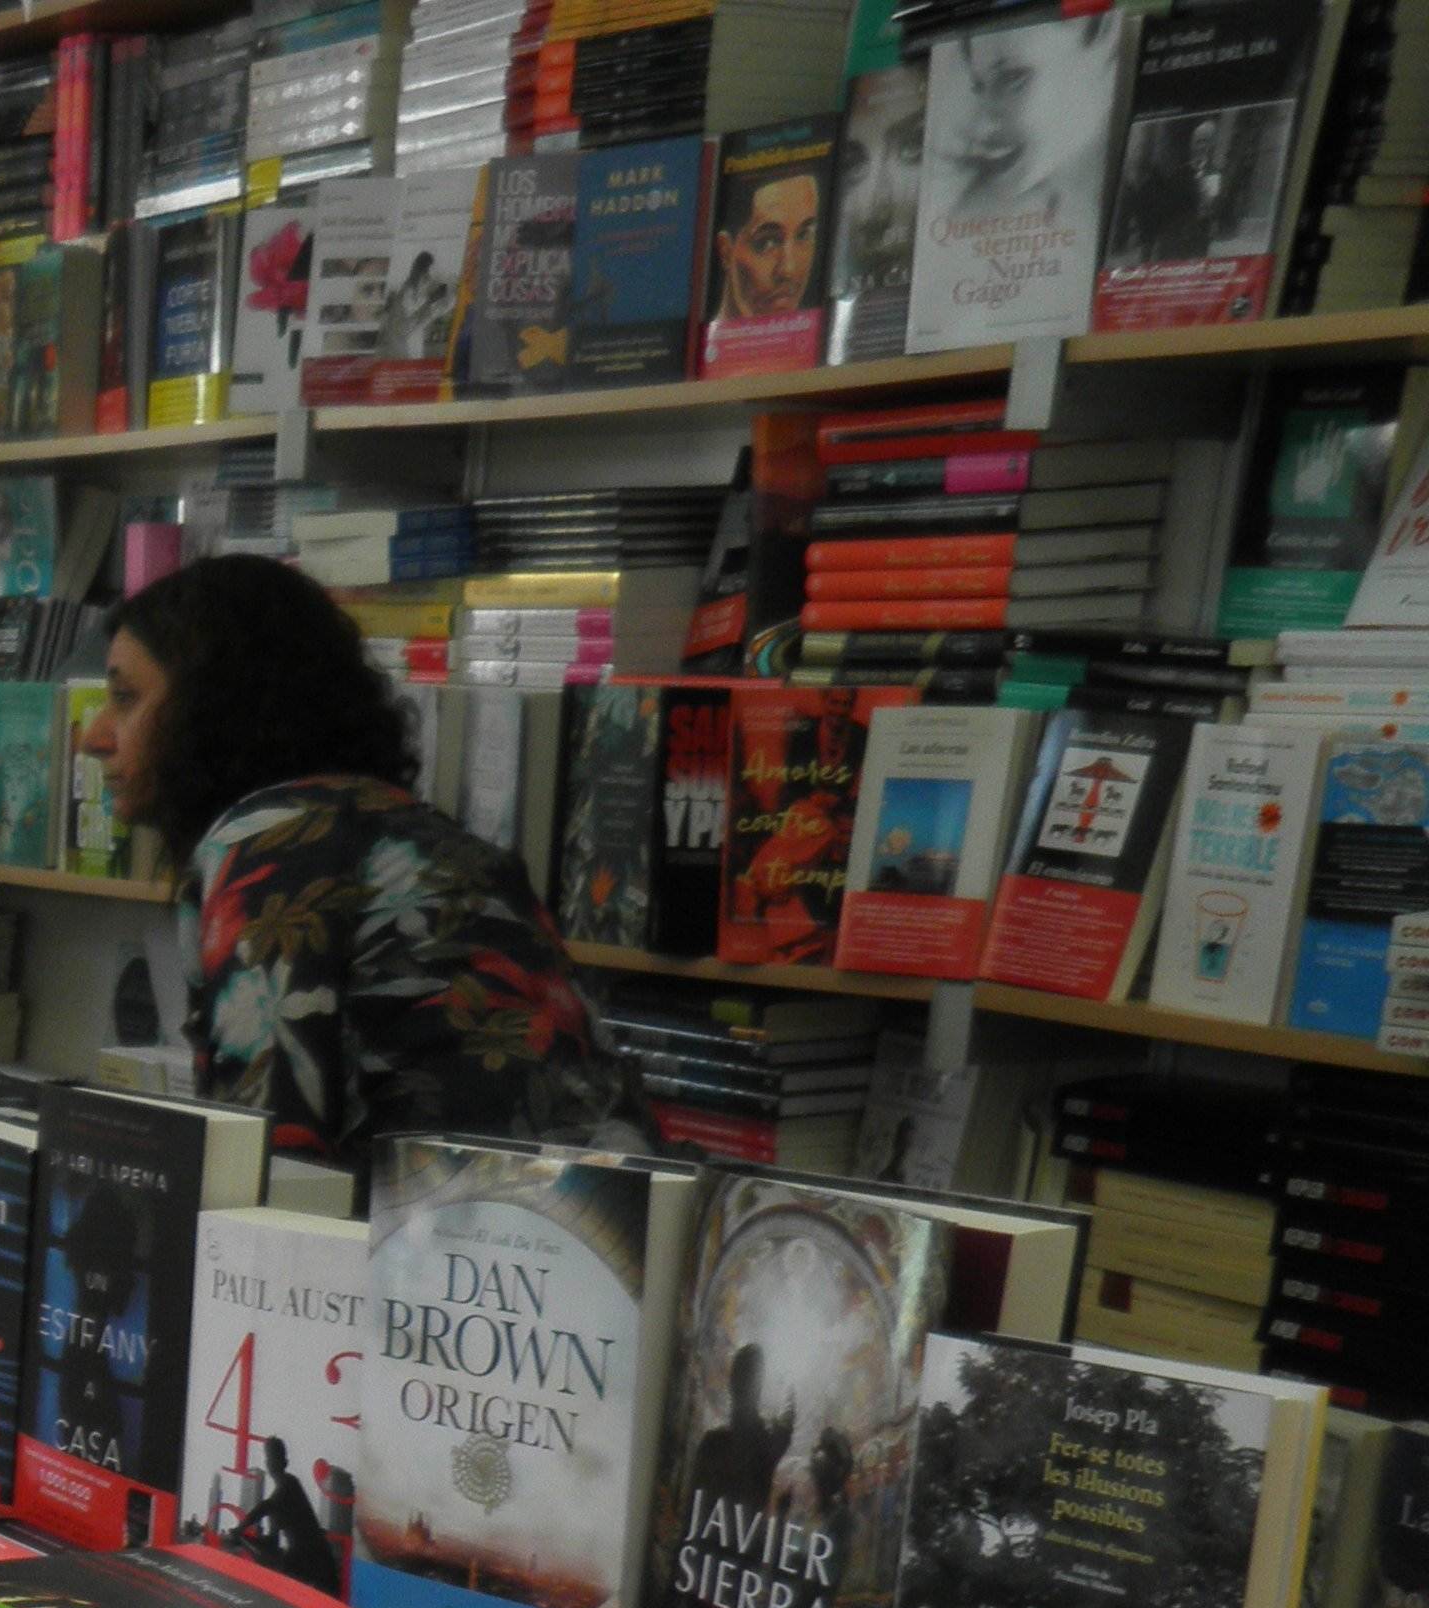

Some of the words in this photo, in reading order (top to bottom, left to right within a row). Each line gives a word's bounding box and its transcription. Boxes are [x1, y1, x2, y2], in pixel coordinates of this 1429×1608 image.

[607, 164, 666, 188] MARK
[591, 189, 679, 216] HADDON
[742, 748, 852, 785] Amores
[735, 808, 826, 837] contra
[212, 1267, 273, 1312] PAUL
[281, 1286, 365, 1328] AUST
[444, 1252, 550, 1319] DAN
[381, 1298, 616, 1401] BROWN
[400, 1378, 580, 1454] ORIGEN
[1064, 1396, 1120, 1434] Josep
[1124, 1408, 1159, 1435] Pla
[52, 1416, 123, 1472] CASA
[1049, 1432, 1110, 1465] Fer-se
[1114, 1450, 1166, 1477] totes
[1044, 1458, 1070, 1487] les
[684, 1488, 834, 1587] JAVIER
[1052, 1499, 1147, 1534] possibles
